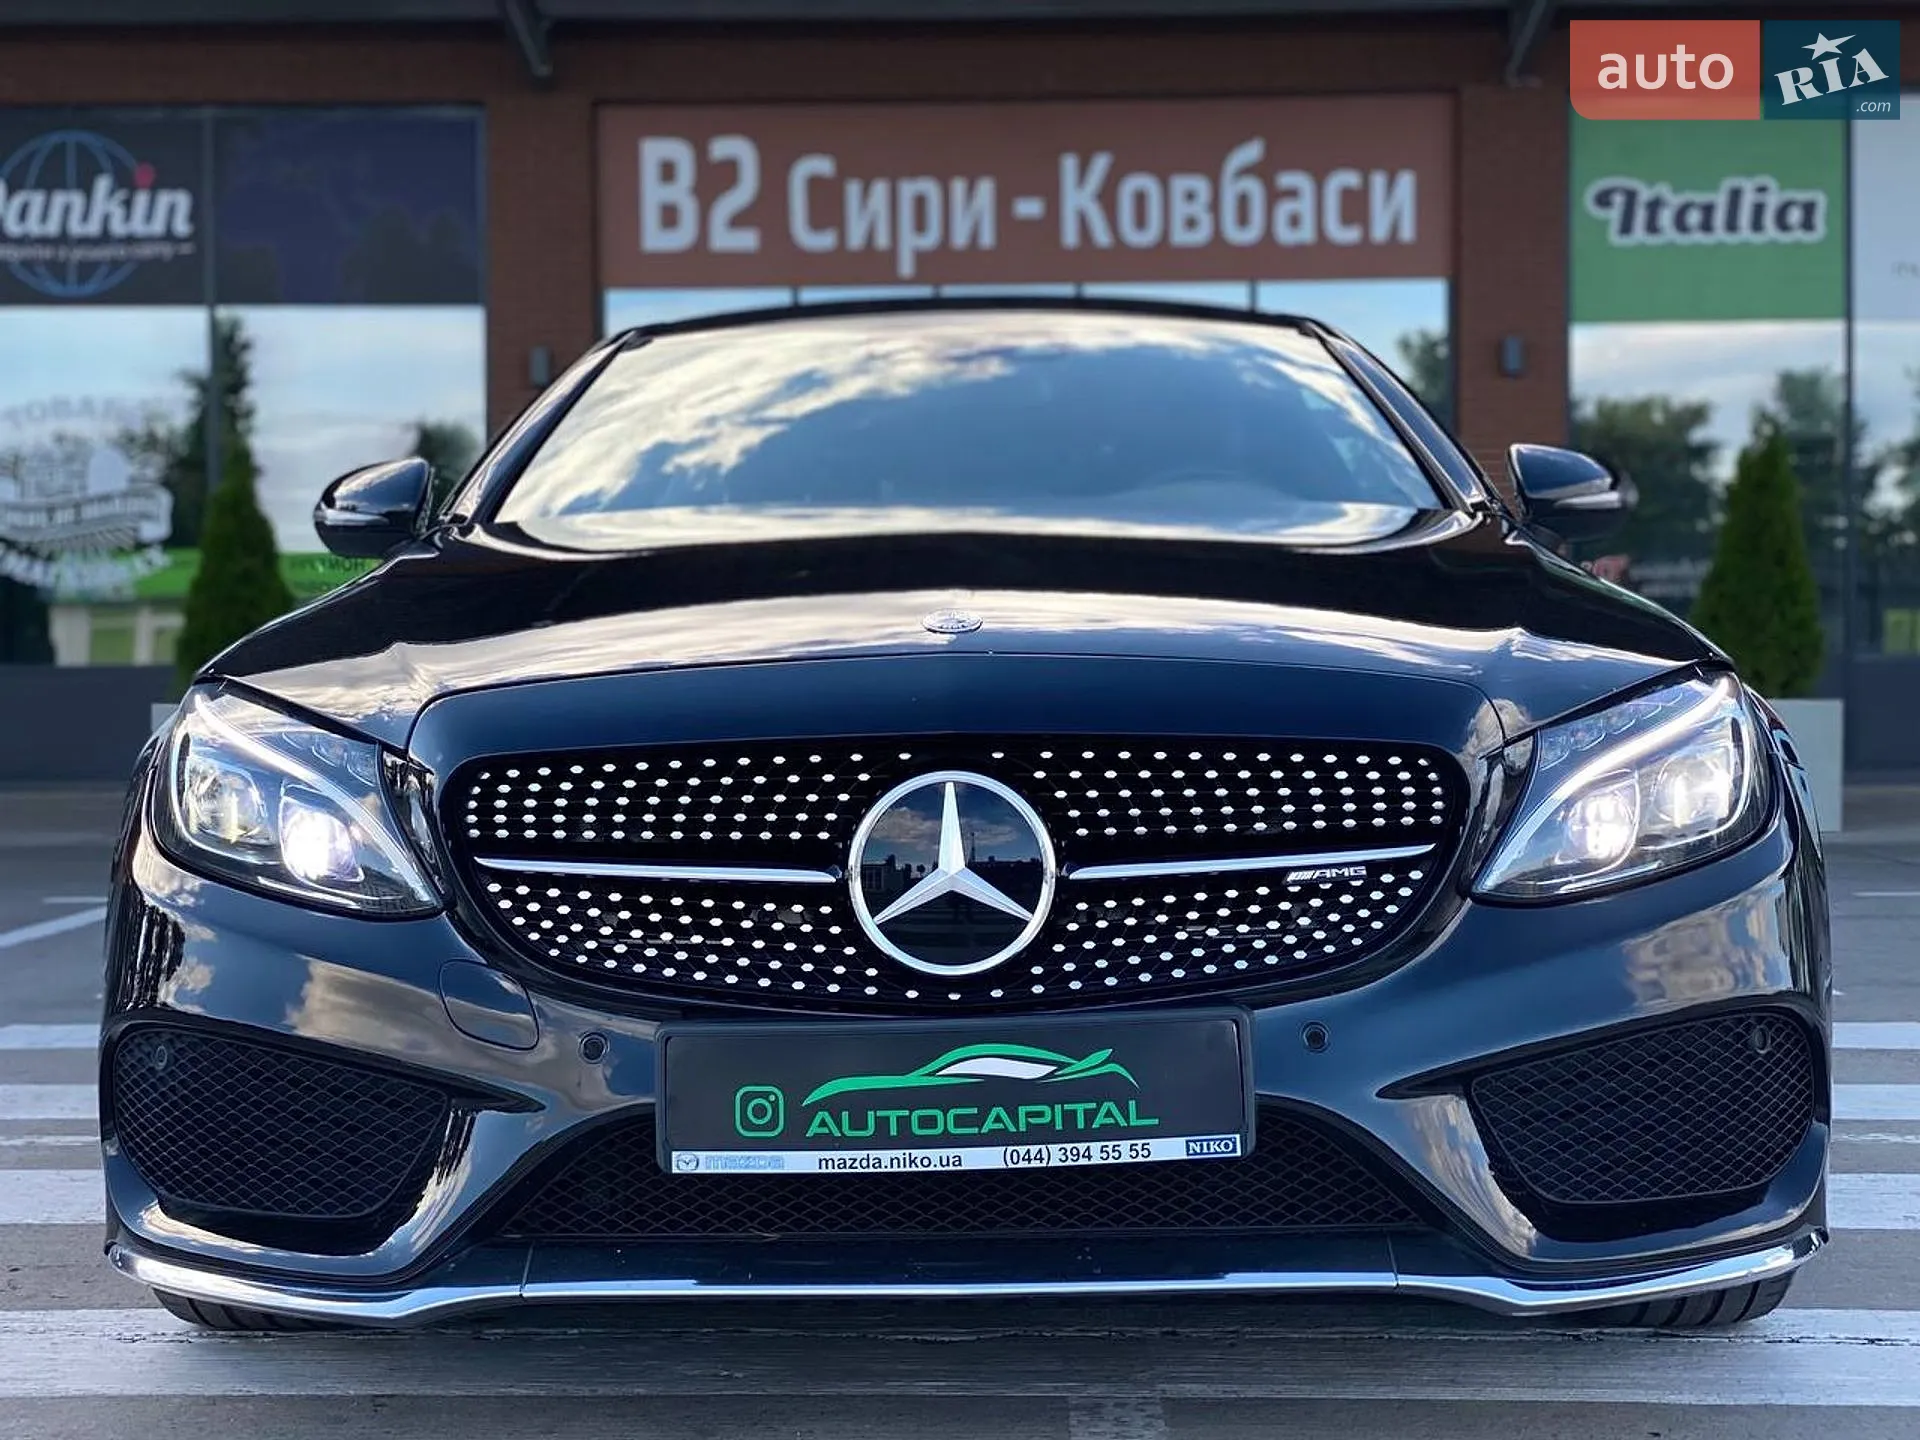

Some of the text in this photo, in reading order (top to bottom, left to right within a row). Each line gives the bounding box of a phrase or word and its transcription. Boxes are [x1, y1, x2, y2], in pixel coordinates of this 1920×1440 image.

[0, 162, 195, 239] ankin
[787, 154, 997, 279] Сири
[1058, 136, 1418, 250] Ковбаси
[1588, 177, 1825, 245] Italia
[1312, 866, 1367, 880] AMG
[805, 1099, 1160, 1138] AUTOCAPITAL
[817, 1143, 1152, 1171] mazda.niko.ua (044) 394 55 55
[1187, 1139, 1234, 1155] NIKO
